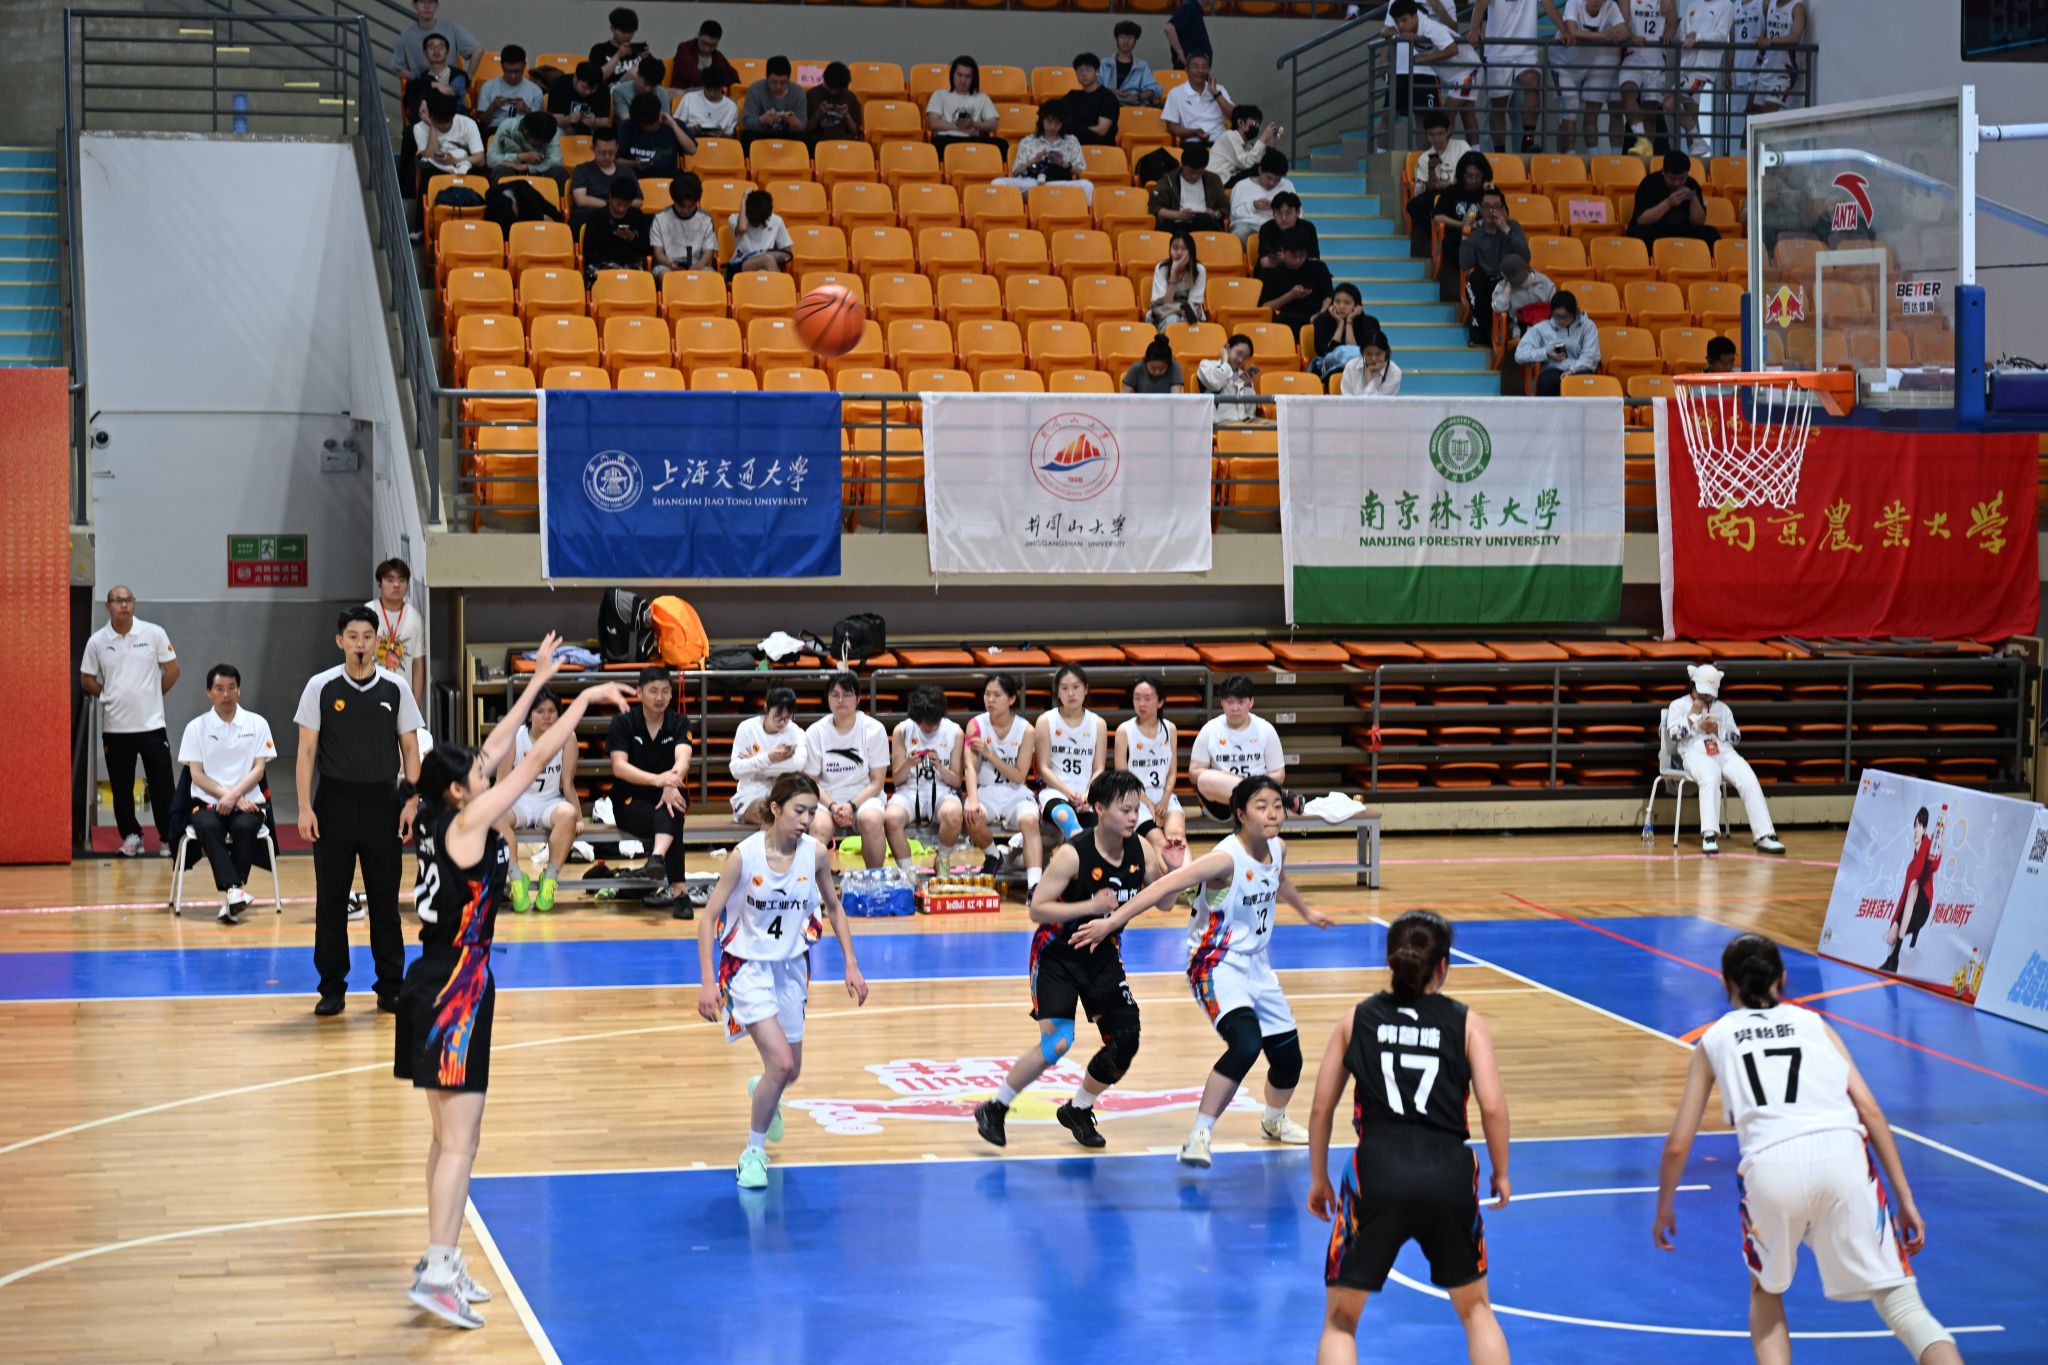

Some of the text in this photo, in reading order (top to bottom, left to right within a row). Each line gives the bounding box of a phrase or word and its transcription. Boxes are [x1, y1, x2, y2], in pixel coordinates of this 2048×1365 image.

[1644, 20, 1656, 34] 12
[1741, 26, 1748, 40] 6
[1832, 203, 1857, 230] ANTA
[652, 497, 808, 508] SHANGHAI JIAO TONG UNIVERSITY
[1360, 535, 1560, 547] NANJING FORESTRY UNIVERSITY
[1062, 759, 1082, 775] 35
[535, 778, 546, 792] 7
[1150, 771, 1160, 787] 3
[967, 898, 984, 910] 红牛
[1855, 898, 1976, 928] 多样活力 随心随行
[767, 914, 783, 940] 4
[1380, 1051, 1440, 1116] 17
[1742, 1046, 1802, 1107] 17
